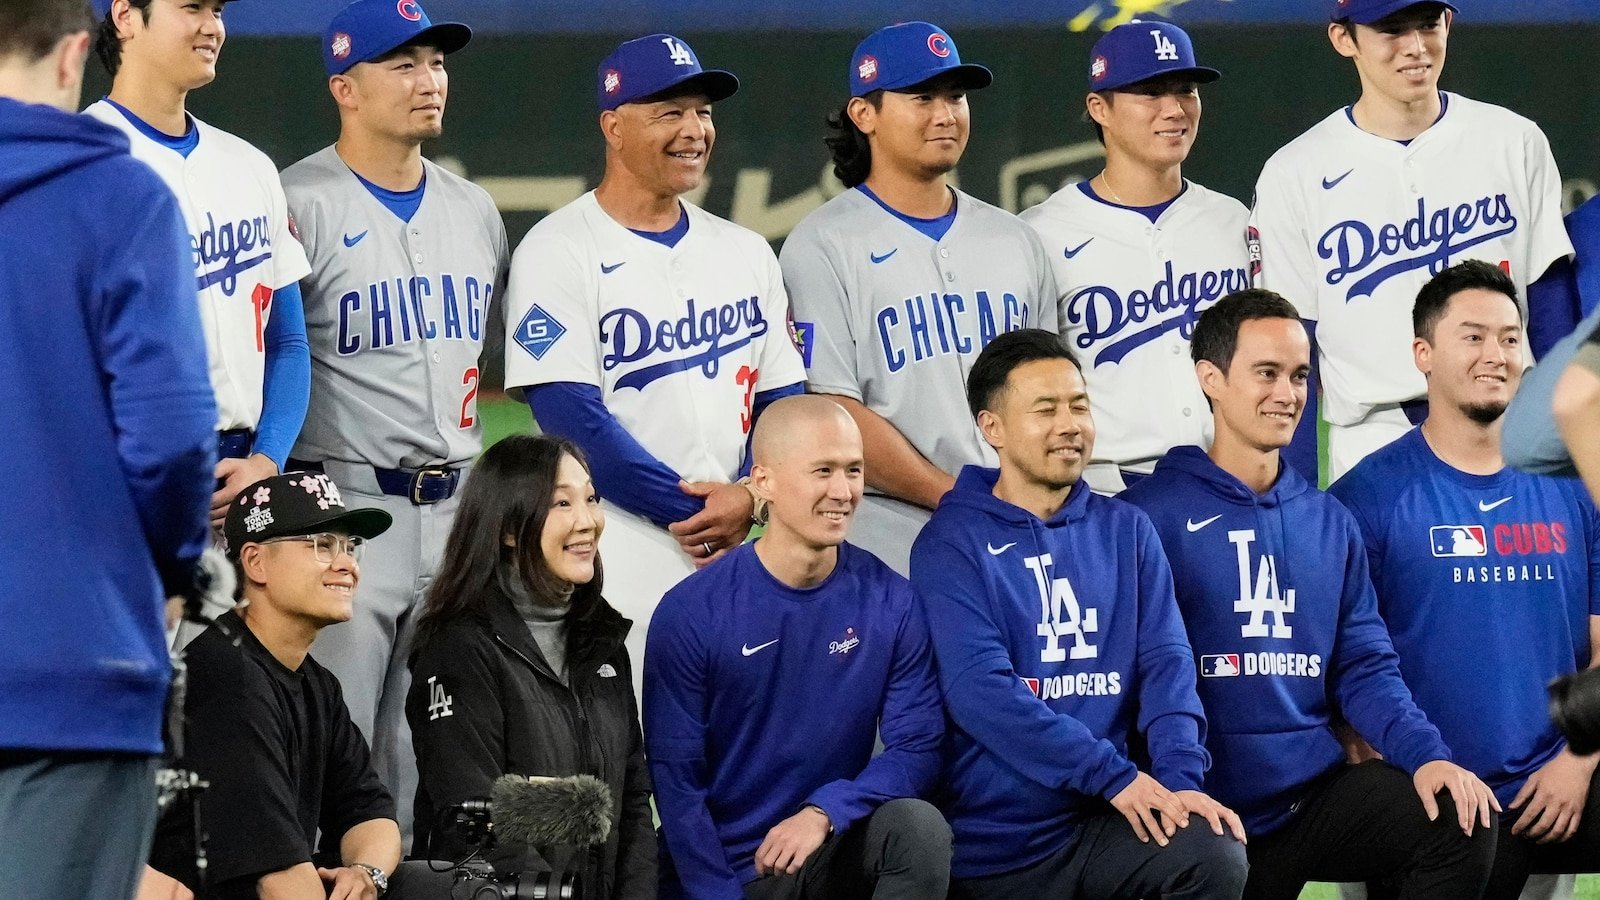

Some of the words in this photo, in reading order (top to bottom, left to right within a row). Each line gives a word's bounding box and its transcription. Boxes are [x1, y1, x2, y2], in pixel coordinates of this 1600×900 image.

[661, 37, 694, 66] LA
[927, 33, 950, 57] C
[1150, 30, 1179, 60] LA
[189, 211, 272, 296] odgers
[1317, 193, 1517, 287] Dodgers
[1067, 260, 1249, 350] Dodgers
[599, 295, 769, 380] Dodgers
[1494, 521, 1568, 556] CUBS
[1228, 529, 1296, 639] LA
[1453, 564, 1555, 583] BASEBALL
[1023, 552, 1098, 663] LA
[1243, 652, 1322, 678] DODGERS
[428, 675, 453, 721] LA
[1042, 671, 1122, 701] DODGERS
